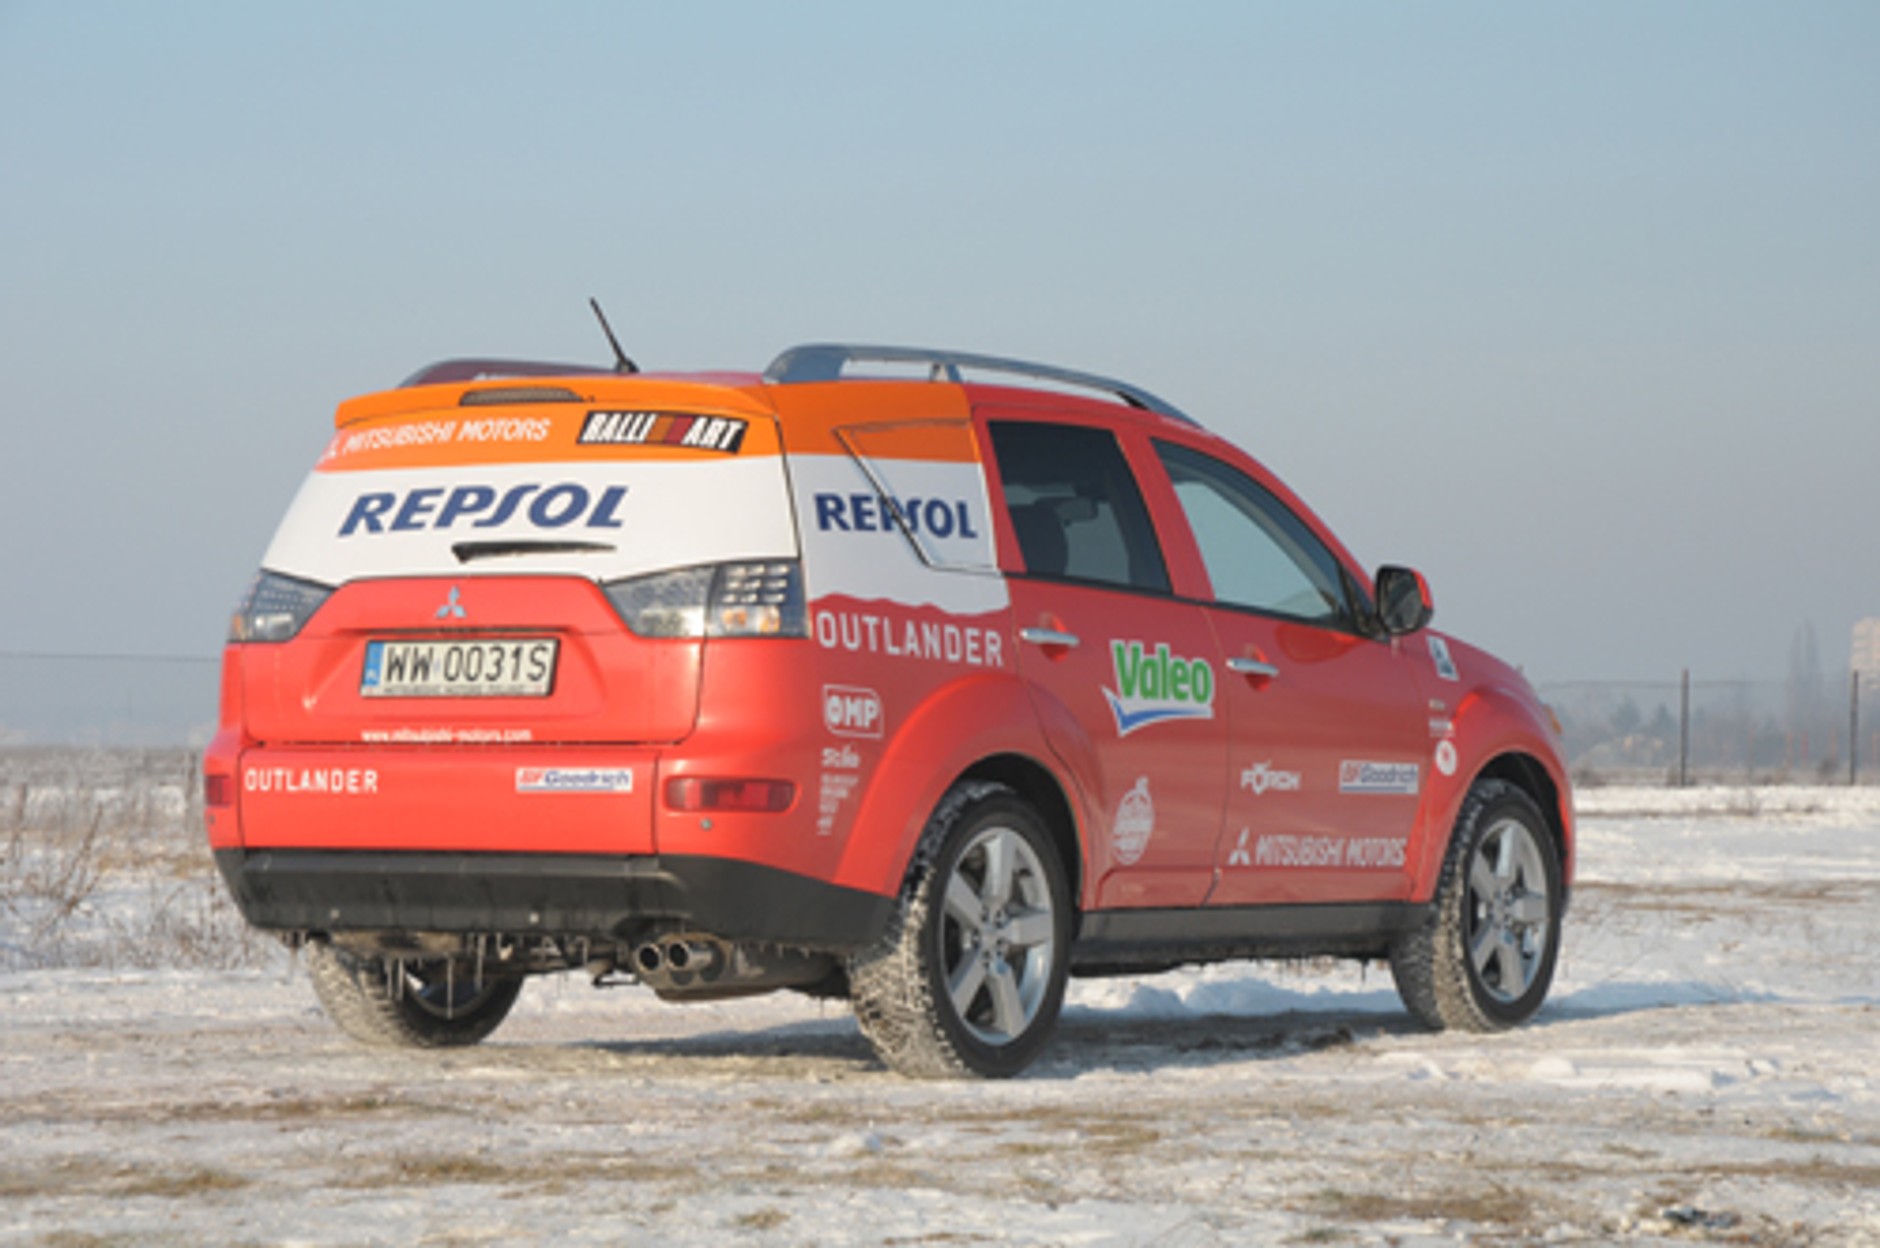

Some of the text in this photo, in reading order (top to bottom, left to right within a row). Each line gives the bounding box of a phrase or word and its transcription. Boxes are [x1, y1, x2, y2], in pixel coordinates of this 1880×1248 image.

[343, 417, 551, 455] MITSUBISHI MOTORS
[681, 416, 743, 449] ART
[337, 483, 630, 537] REPSOL
[814, 492, 979, 539] REPSOL
[816, 610, 1004, 667] OUTLANDER
[384, 645, 549, 682] WW 0031S
[1112, 640, 1213, 704] Valeo
[827, 695, 878, 729] OMP
[244, 768, 378, 794] OUTLANDER
[1256, 834, 1407, 867] MITSUBISHI MOTORS
